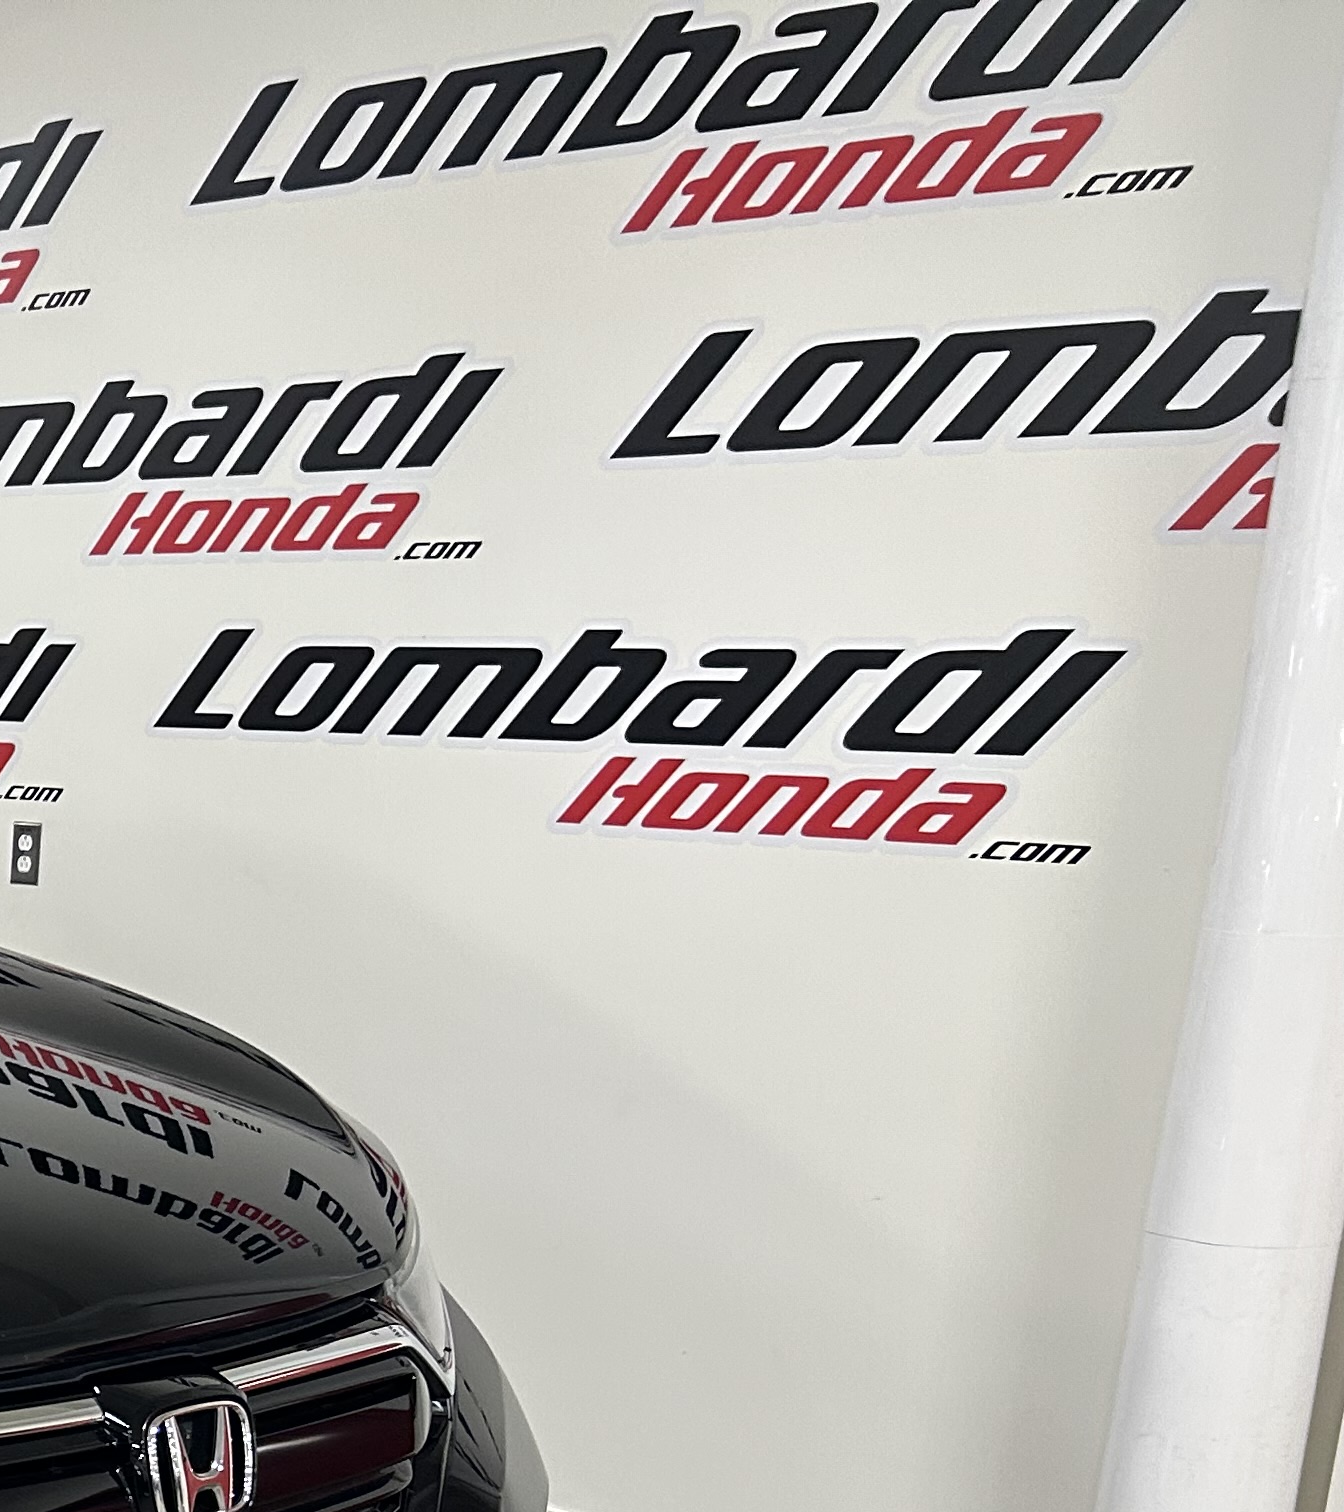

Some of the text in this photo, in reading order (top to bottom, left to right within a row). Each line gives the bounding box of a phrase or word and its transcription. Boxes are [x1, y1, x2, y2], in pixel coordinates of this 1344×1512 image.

[190, 0, 1185, 205] Lombardi
[621, 109, 1193, 232] Honda .com
[22, 289, 91, 311] .com
[610, 289, 1302, 459] Lomb
[92, 484, 482, 560] Honda .com
[154, 629, 1128, 756] Lombardi
[560, 756, 1091, 864] Honda .com
